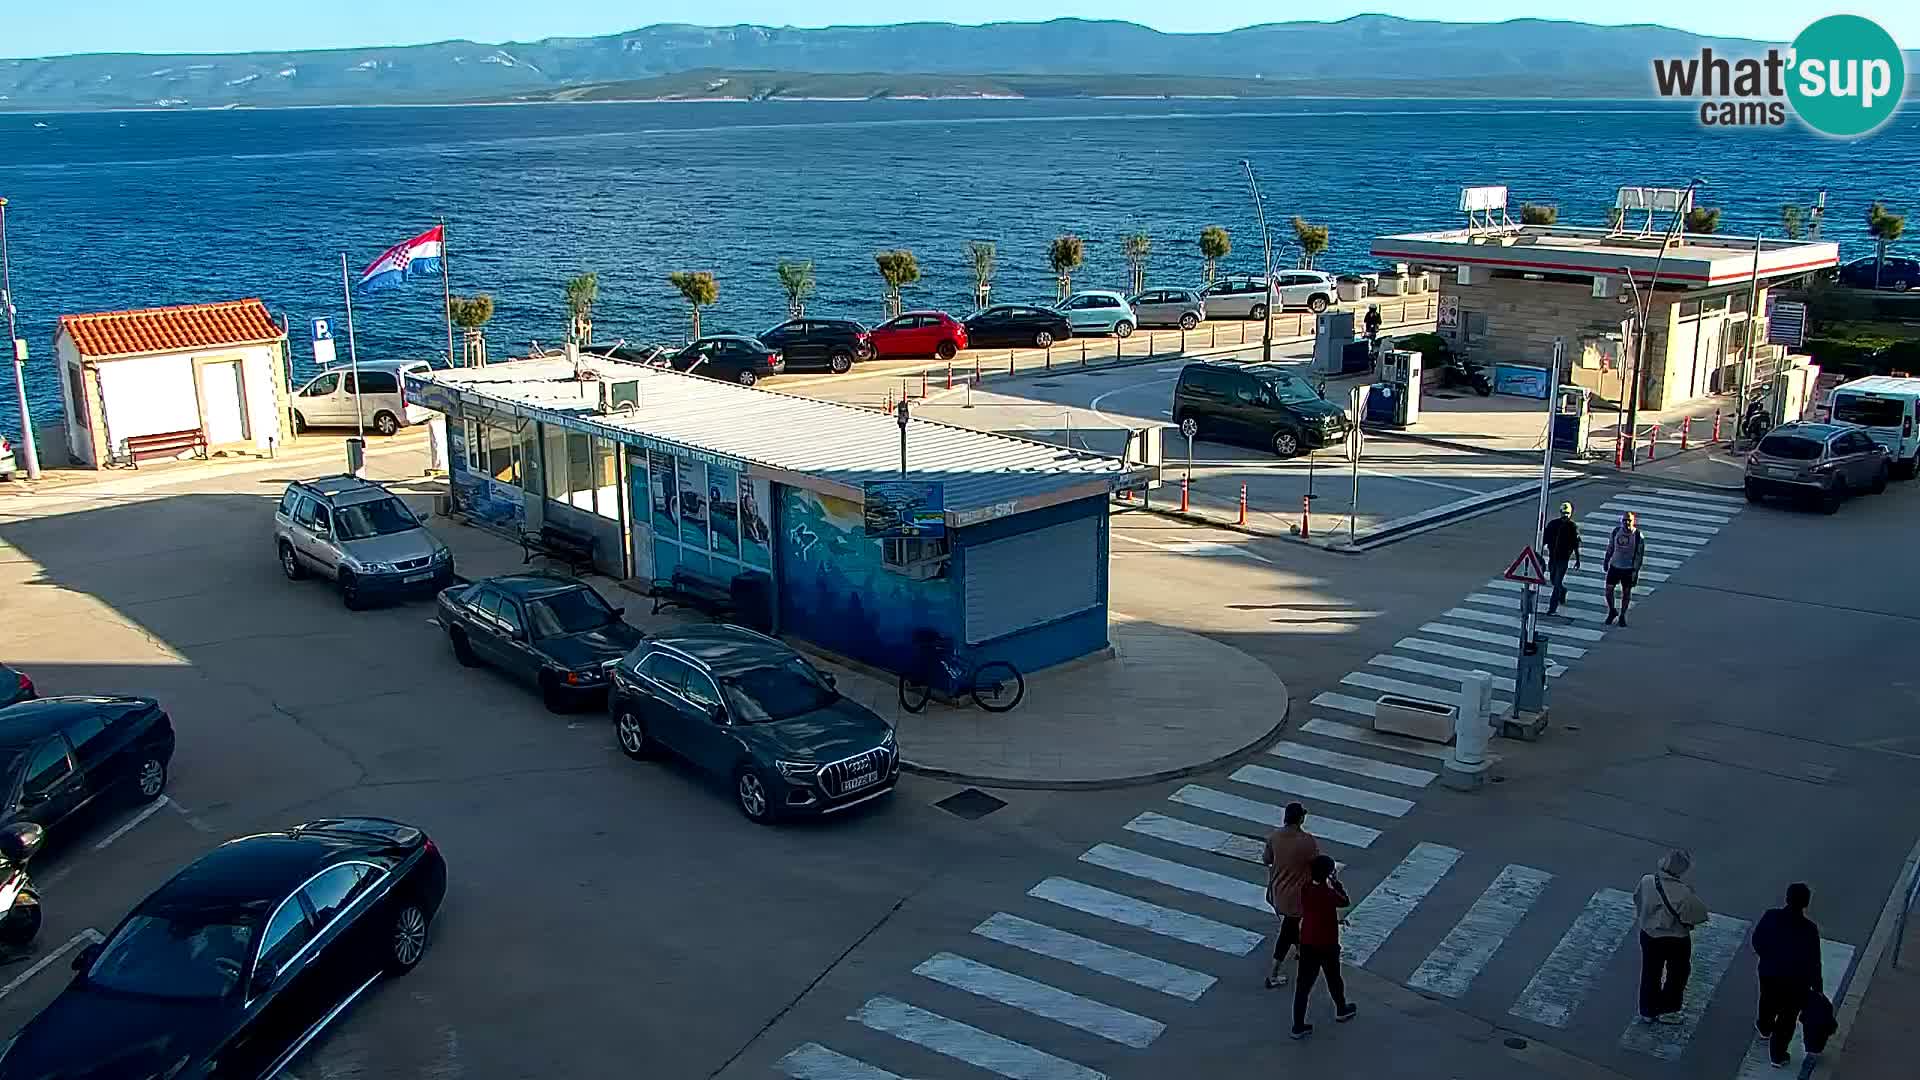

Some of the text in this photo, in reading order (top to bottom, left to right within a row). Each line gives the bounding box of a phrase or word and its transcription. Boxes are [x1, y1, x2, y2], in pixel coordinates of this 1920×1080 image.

[315, 319, 328, 339] P
[643, 438, 657, 451] BUS
[658, 441, 689, 457] STATION
[691, 449, 716, 465] TICKET
[717, 456, 744, 471] OFFICE
